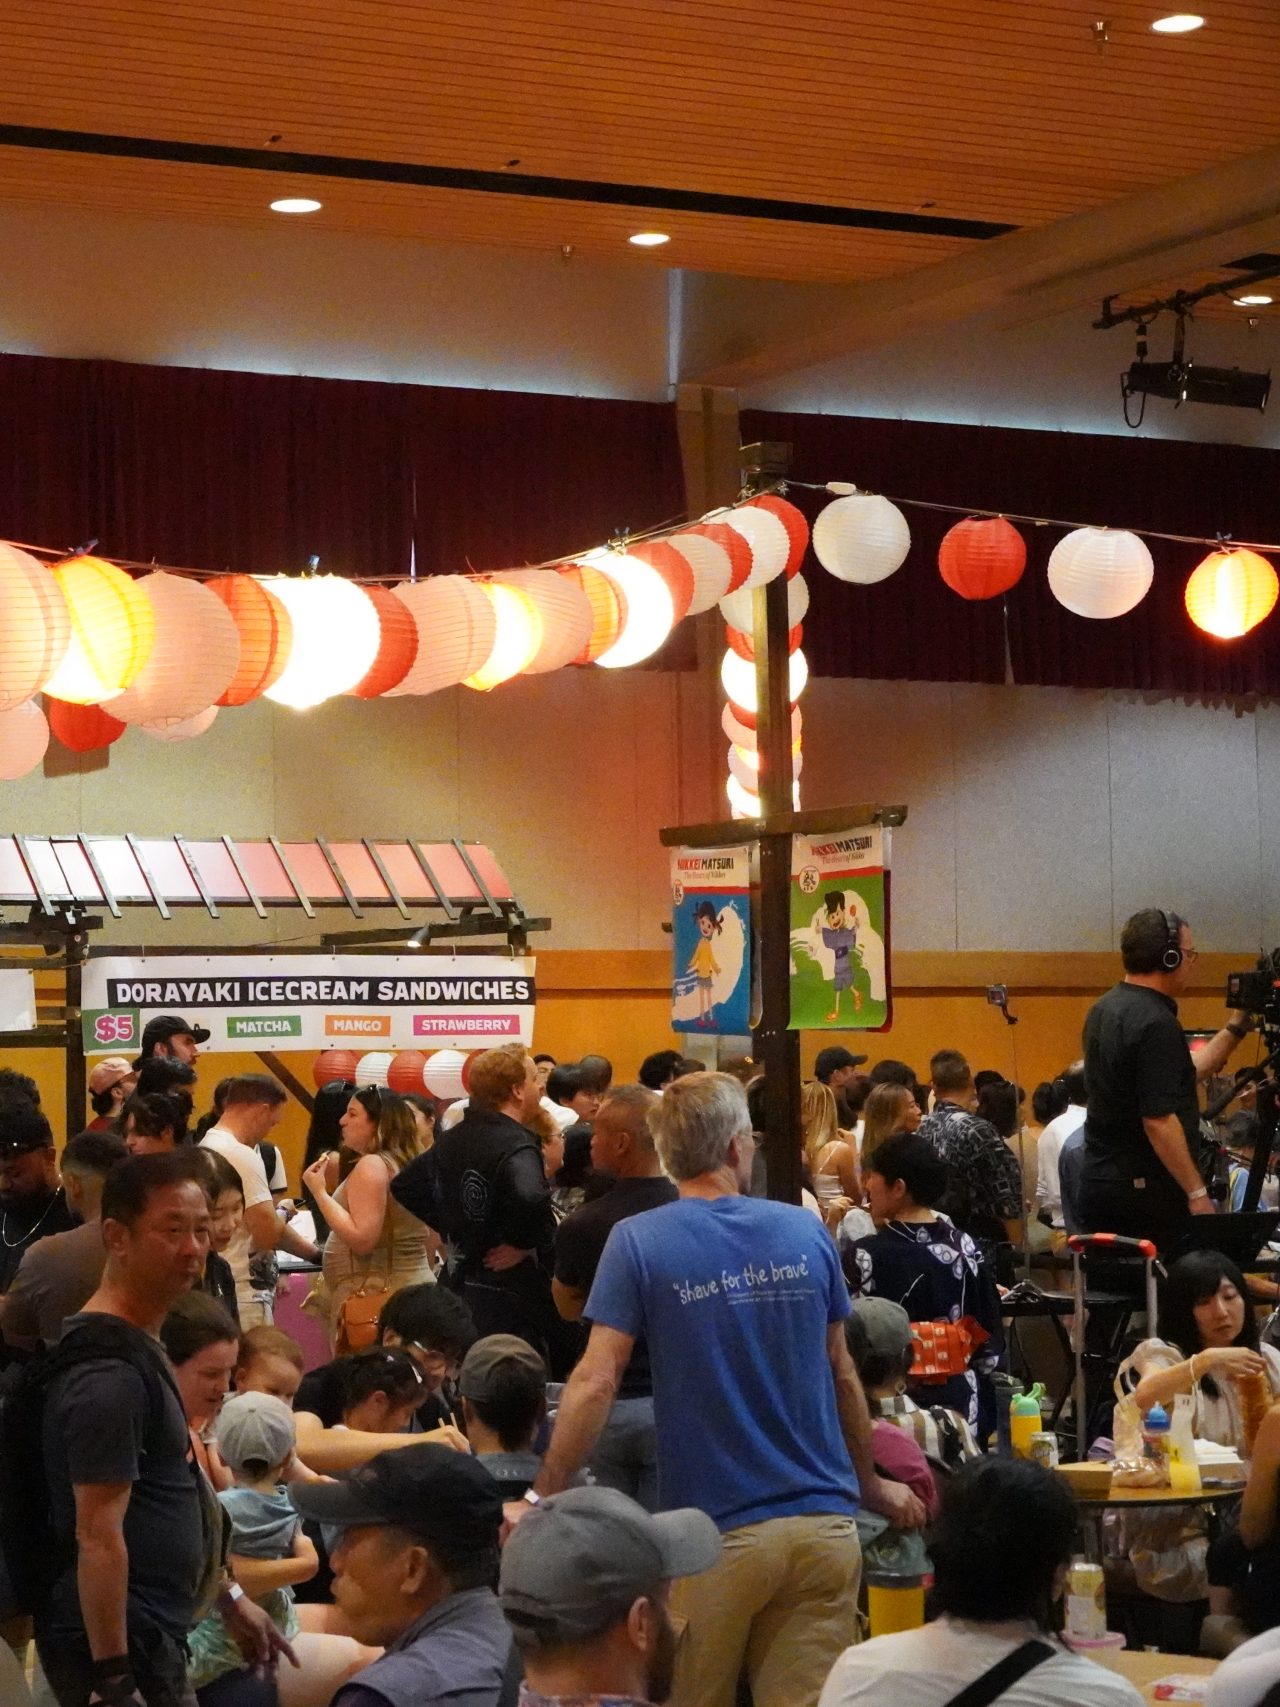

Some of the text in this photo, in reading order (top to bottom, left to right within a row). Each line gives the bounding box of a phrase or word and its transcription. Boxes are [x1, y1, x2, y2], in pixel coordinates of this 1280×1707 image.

[116, 980, 530, 1003] DORAYAKI ICECREAM SANDWICHES
[95, 1014, 133, 1043] $5
[236, 1020, 292, 1033] MATCHA
[333, 1020, 382, 1031] MANGO
[422, 1019, 511, 1031] STRAWBERRY
[722, 1270, 741, 1292] for
[743, 1263, 769, 1288] the
